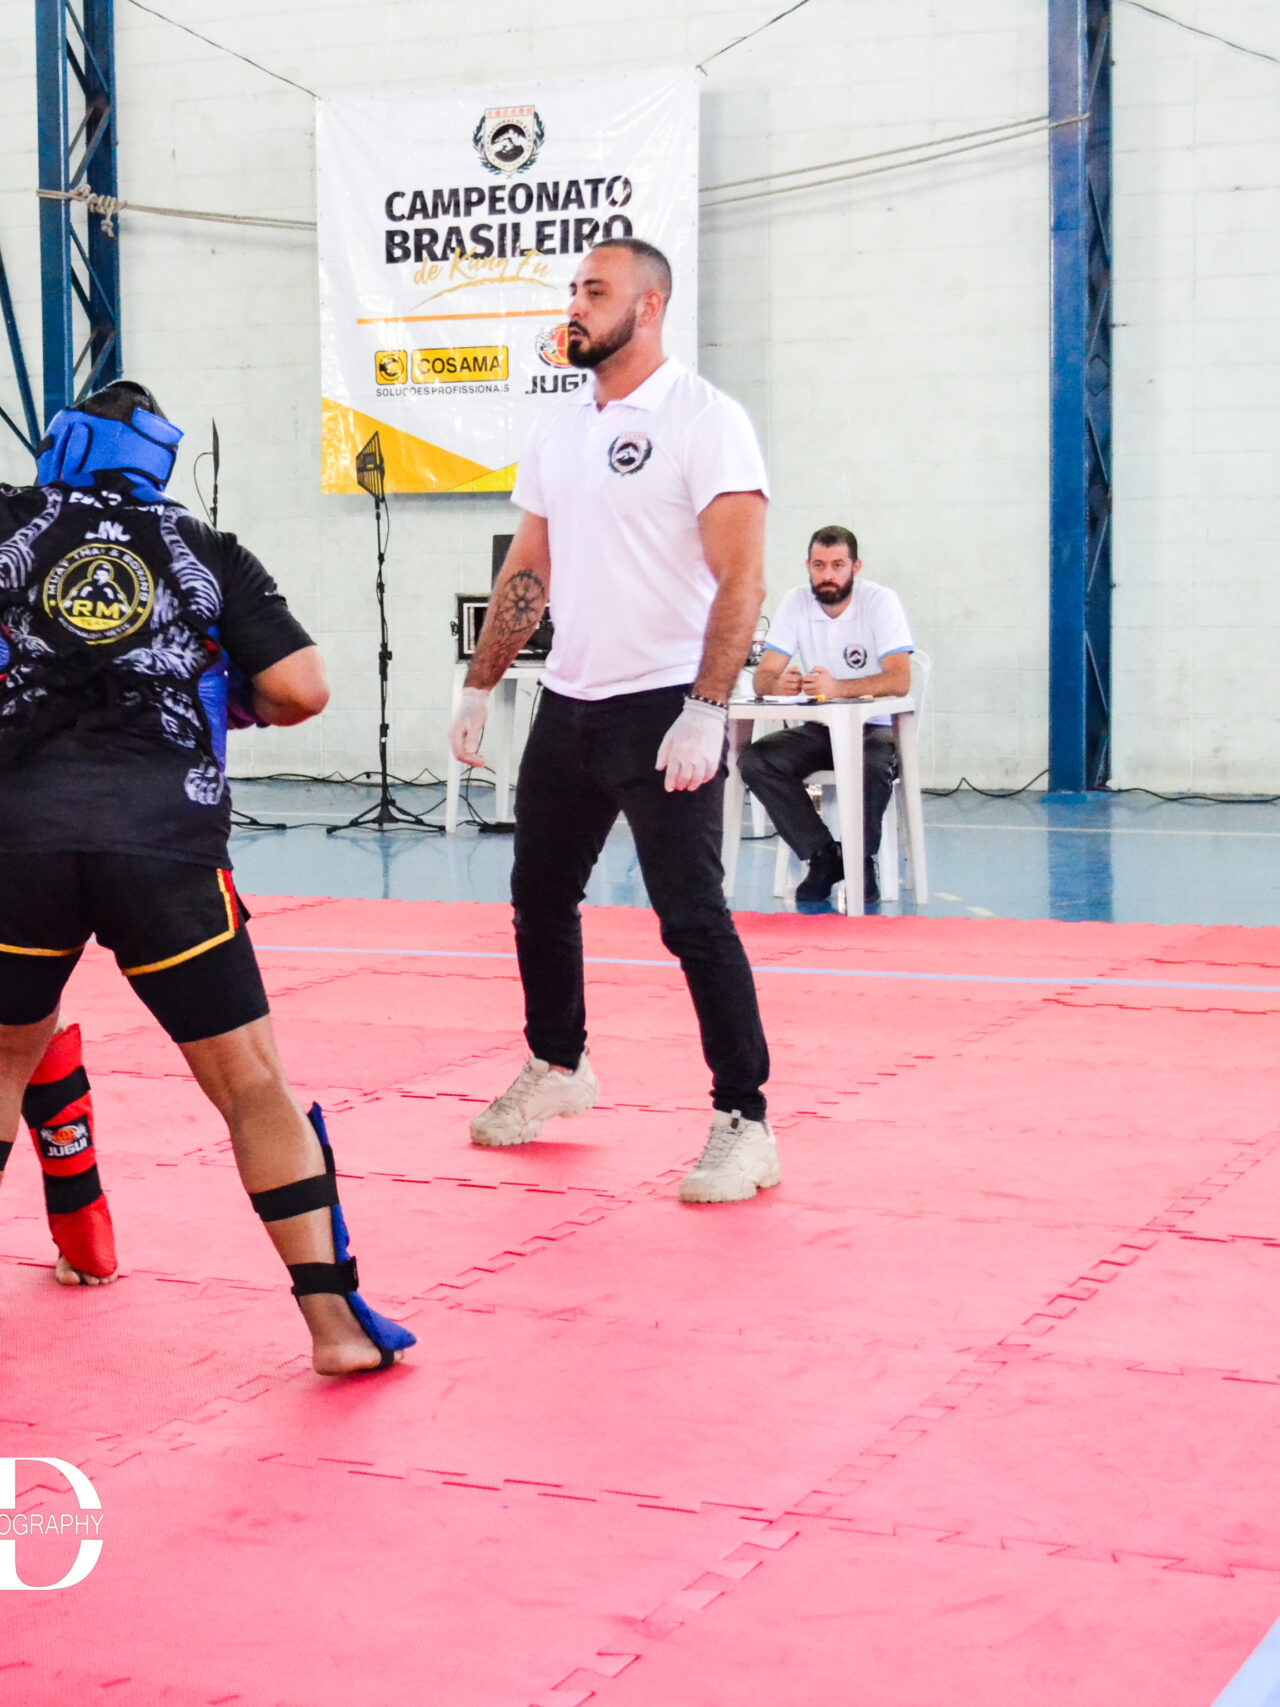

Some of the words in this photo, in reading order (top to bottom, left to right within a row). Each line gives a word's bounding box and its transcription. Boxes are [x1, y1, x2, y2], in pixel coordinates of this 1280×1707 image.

[385, 175, 632, 222] CAMPEONATO
[385, 214, 633, 264] BRASILEIRO
[413, 256, 442, 285] de
[449, 246, 510, 280] Kung
[418, 355, 502, 375] COSAMA
[72, 599, 120, 619] RM
[47, 1137, 88, 1157] JUGUI
